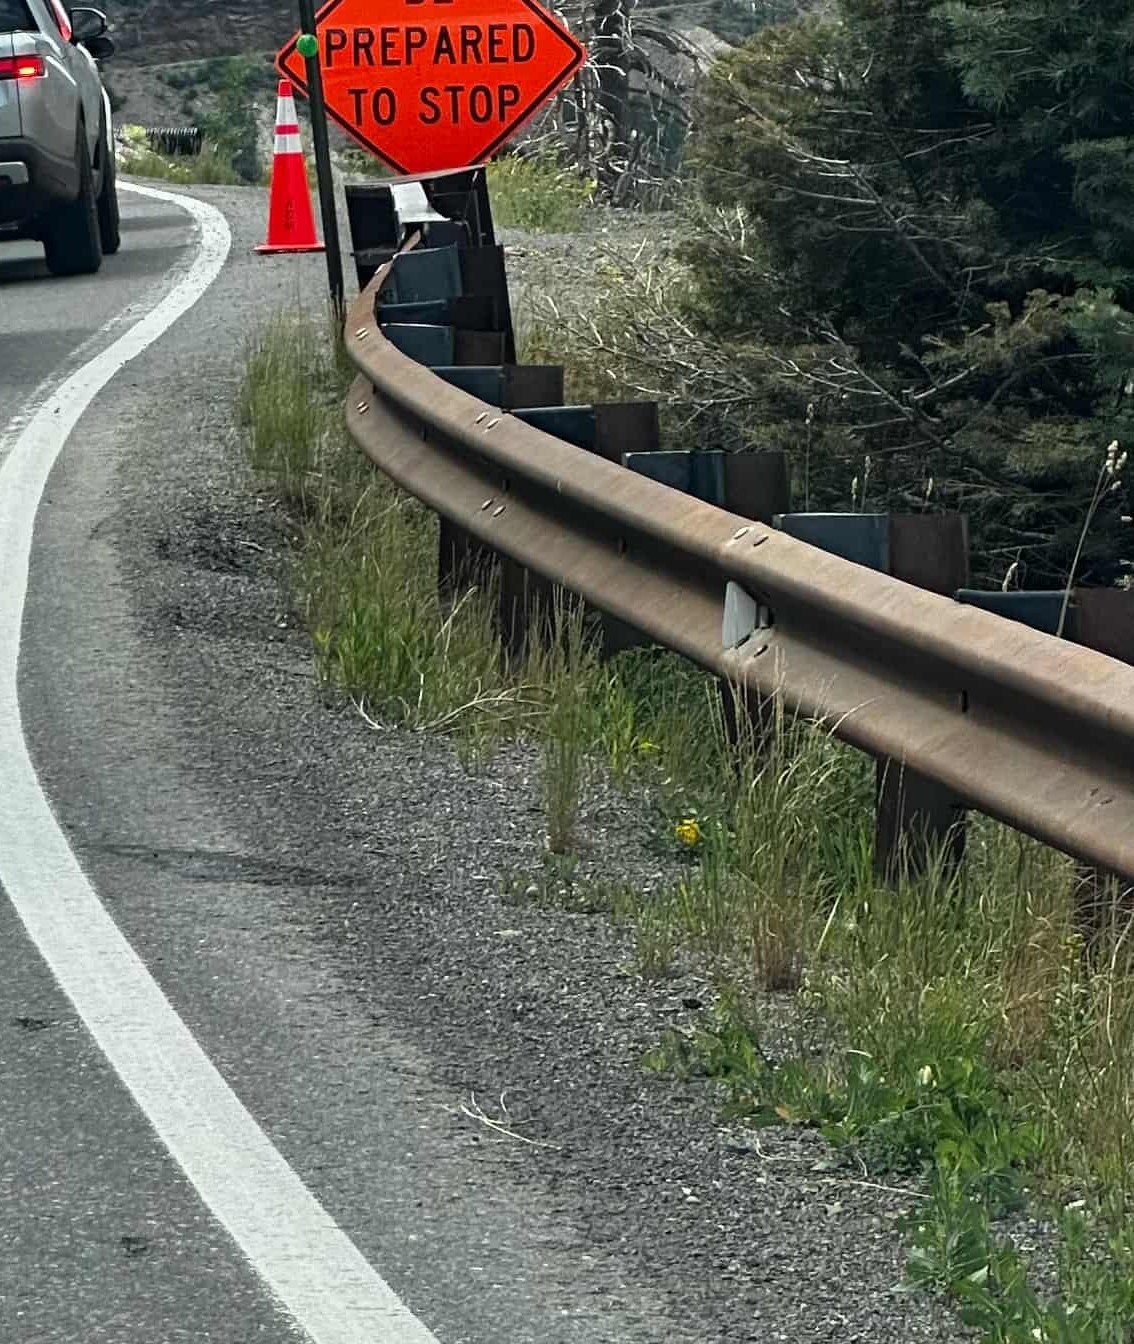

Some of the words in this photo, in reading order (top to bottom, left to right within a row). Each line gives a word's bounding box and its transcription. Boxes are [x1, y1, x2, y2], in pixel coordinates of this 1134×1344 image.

[324, 22, 536, 67] PREPARED
[348, 87, 397, 126] TO
[419, 84, 521, 125] STOP
